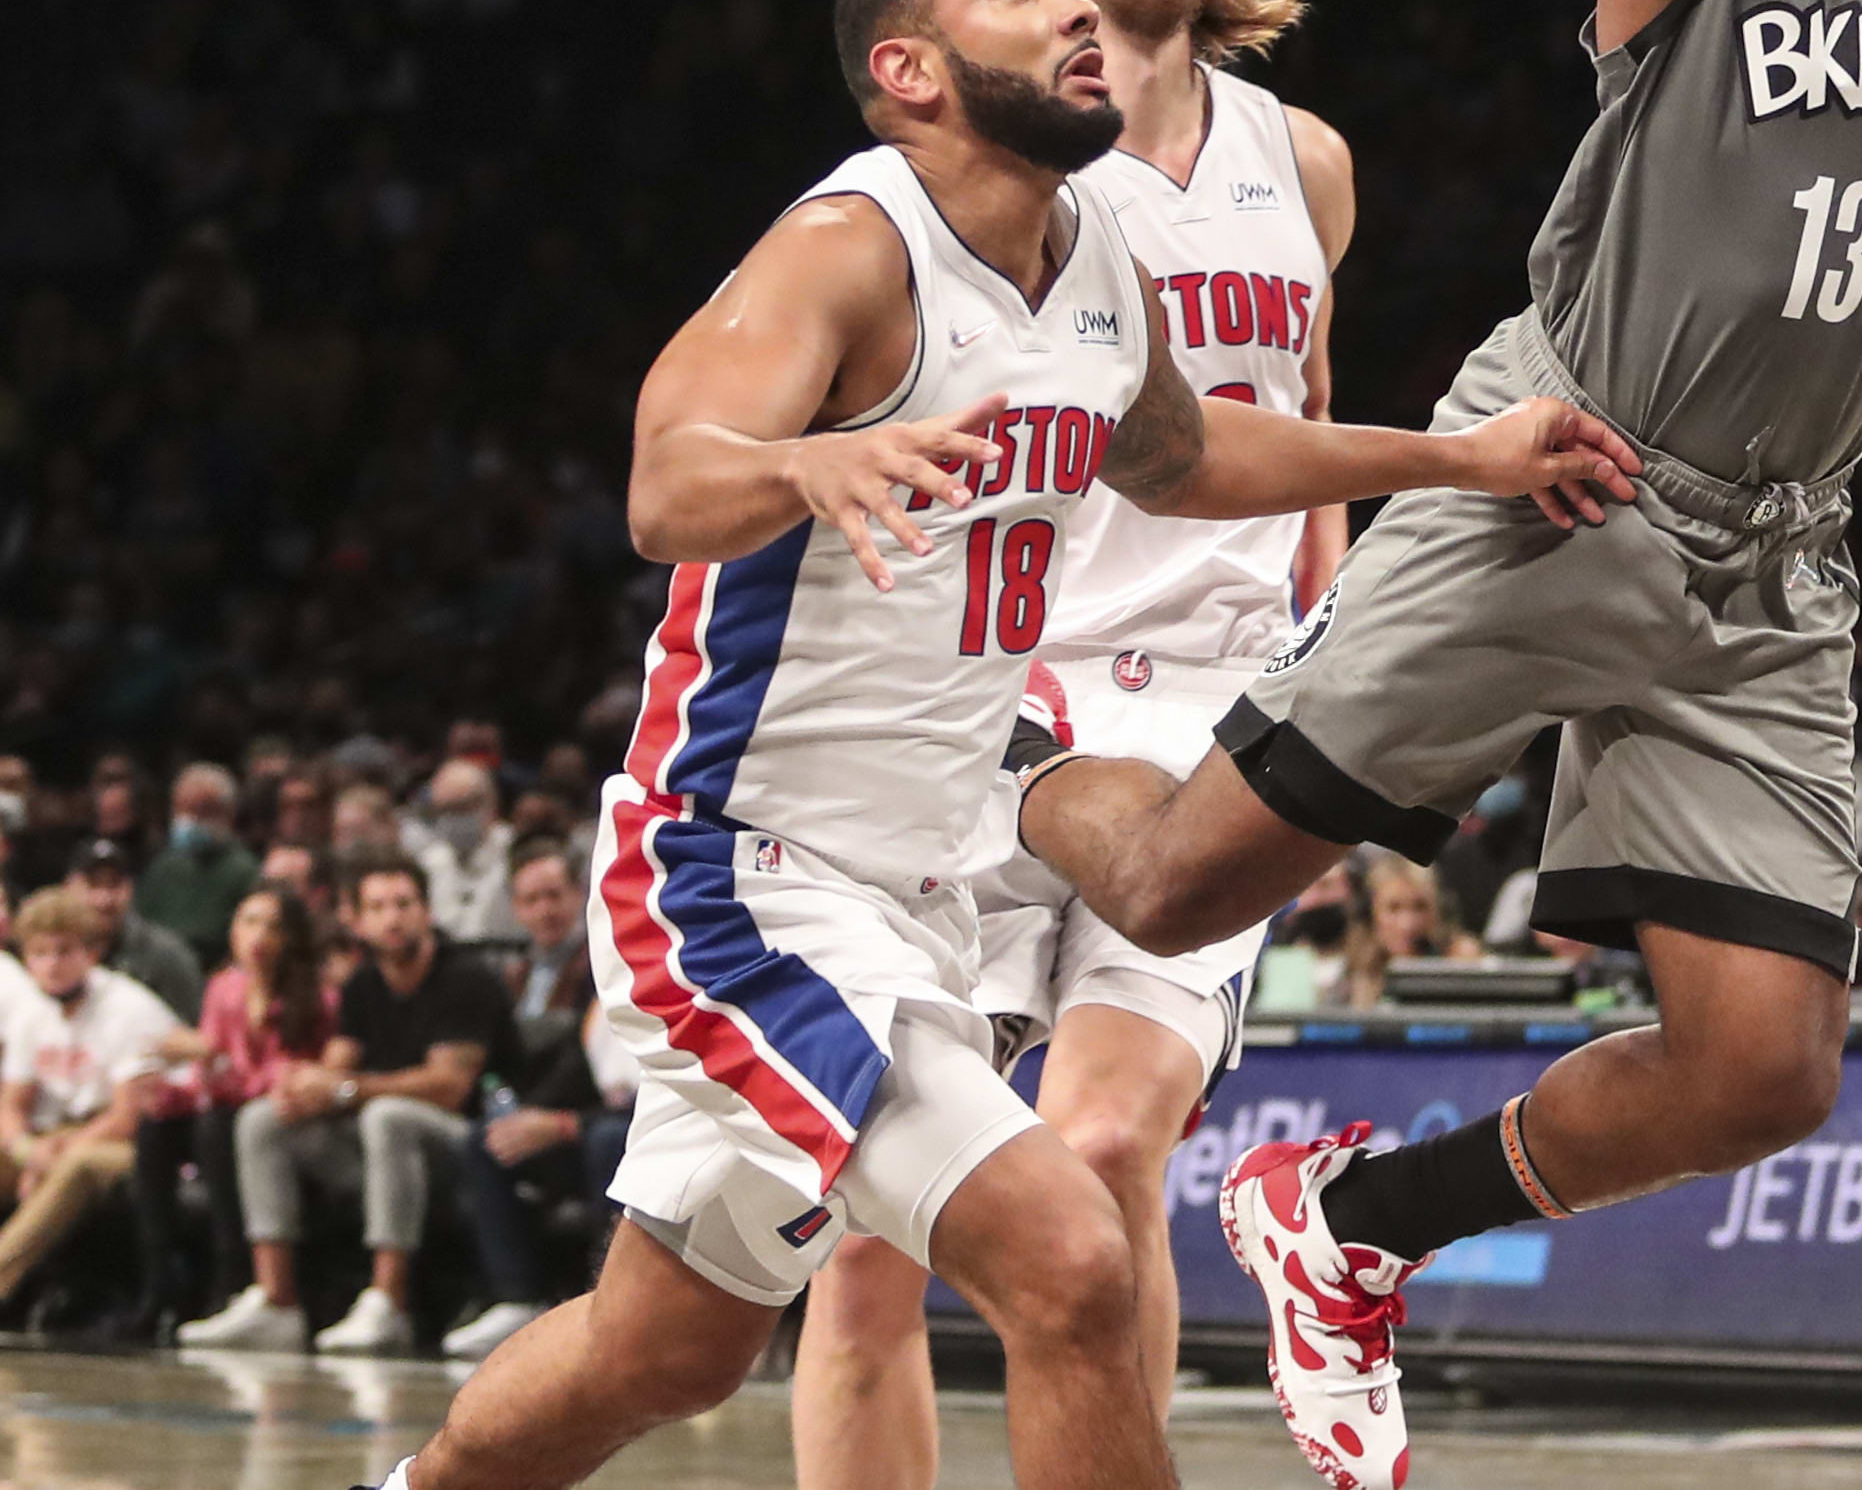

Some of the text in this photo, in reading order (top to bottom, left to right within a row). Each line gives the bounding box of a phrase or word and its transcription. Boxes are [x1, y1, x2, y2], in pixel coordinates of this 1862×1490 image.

[1229, 183, 1278, 203] UWM
[1073, 309, 1119, 336] UWM
[1152, 271, 1311, 355] TONS
[958, 517, 1055, 657] 18
